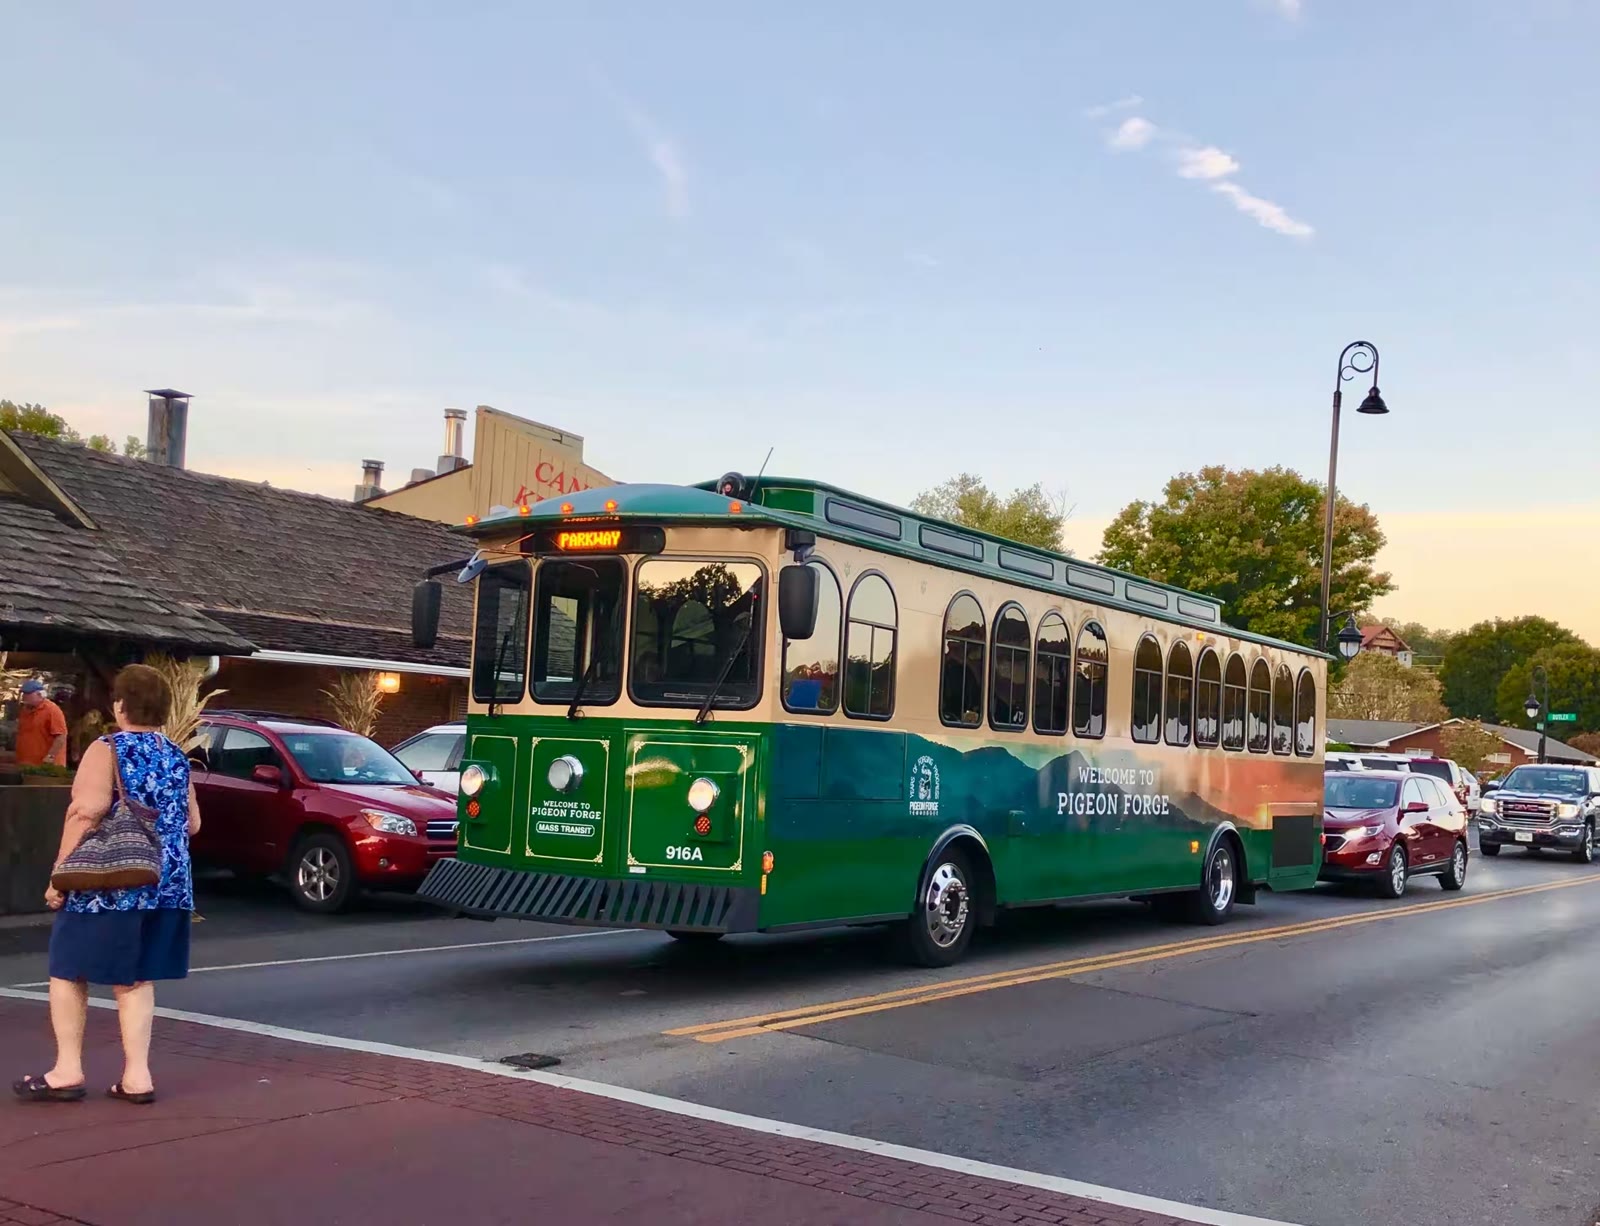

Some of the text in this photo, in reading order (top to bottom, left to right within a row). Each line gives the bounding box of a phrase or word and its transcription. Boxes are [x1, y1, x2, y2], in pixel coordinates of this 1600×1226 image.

[560, 530, 621, 548] PARKWAY
[1078, 766, 1154, 786] WELCOME TO
[543, 800, 591, 810] WELCOME TO
[1057, 792, 1170, 815] PIGEON FORGE
[531, 806, 602, 820] PIGEON FORGE
[538, 823, 592, 834] MASS TRANSIT
[665, 845, 703, 861] 916A
